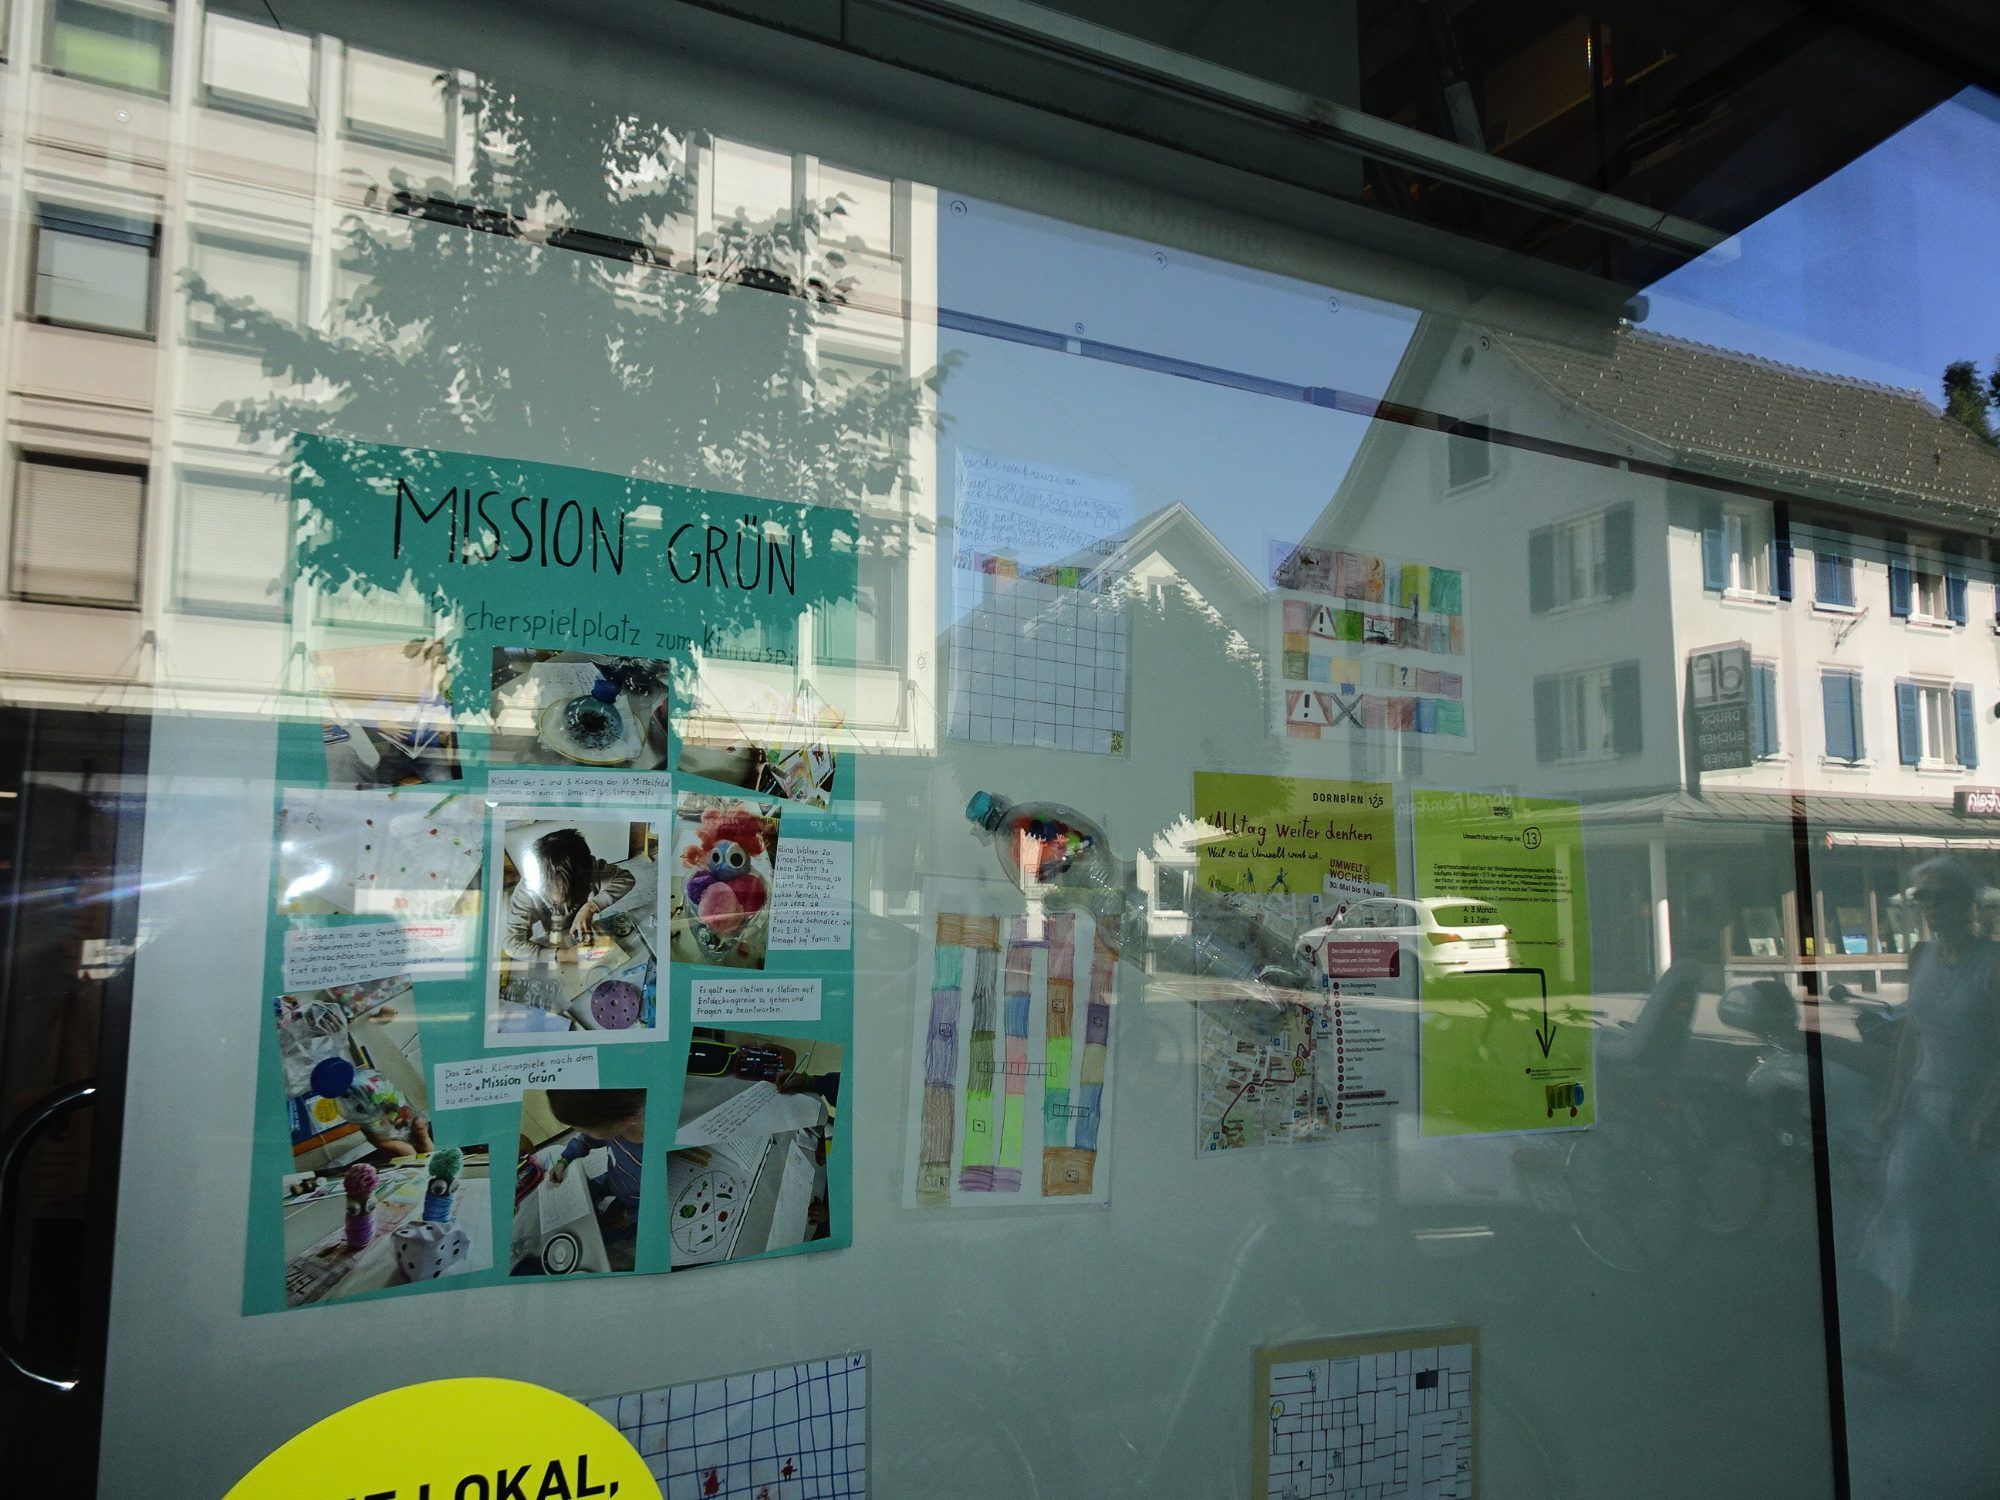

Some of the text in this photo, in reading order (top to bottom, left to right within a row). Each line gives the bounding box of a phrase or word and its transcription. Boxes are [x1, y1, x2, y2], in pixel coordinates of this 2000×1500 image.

[393, 477, 796, 596] MISSION GRÜN
[656, 631, 691, 651] zum
[1313, 792, 1364, 804] DORNBIRN
[1326, 820, 1373, 841] denken
[1525, 832, 1538, 845] 13
[1207, 846, 1226, 859] Weil
[1238, 848, 1249, 858] die
[1252, 846, 1285, 859] Umwelt
[1288, 850, 1306, 860] wert
[1330, 858, 1363, 873] UMWELT
[1329, 868, 1363, 884] WOCHE
[1329, 881, 1338, 890] 30.
[1339, 883, 1351, 892] Mai
[1352, 885, 1361, 894] bis
[1373, 889, 1385, 897] Juni
[358, 929, 372, 939] der
[699, 985, 706, 994] Es
[739, 984, 764, 993] Station
[777, 984, 800, 993] Station
[801, 984, 814, 994] auf
[792, 995, 805, 1003] und
[697, 1007, 722, 1017] Fragen
[445, 1069, 460, 1079] Das
[491, 1058, 545, 1073] Klimaspiele
[550, 1055, 573, 1066] nach
[575, 1053, 594, 1064] dem
[445, 1081, 473, 1094] Motto
[445, 1096, 455, 1105] zu
